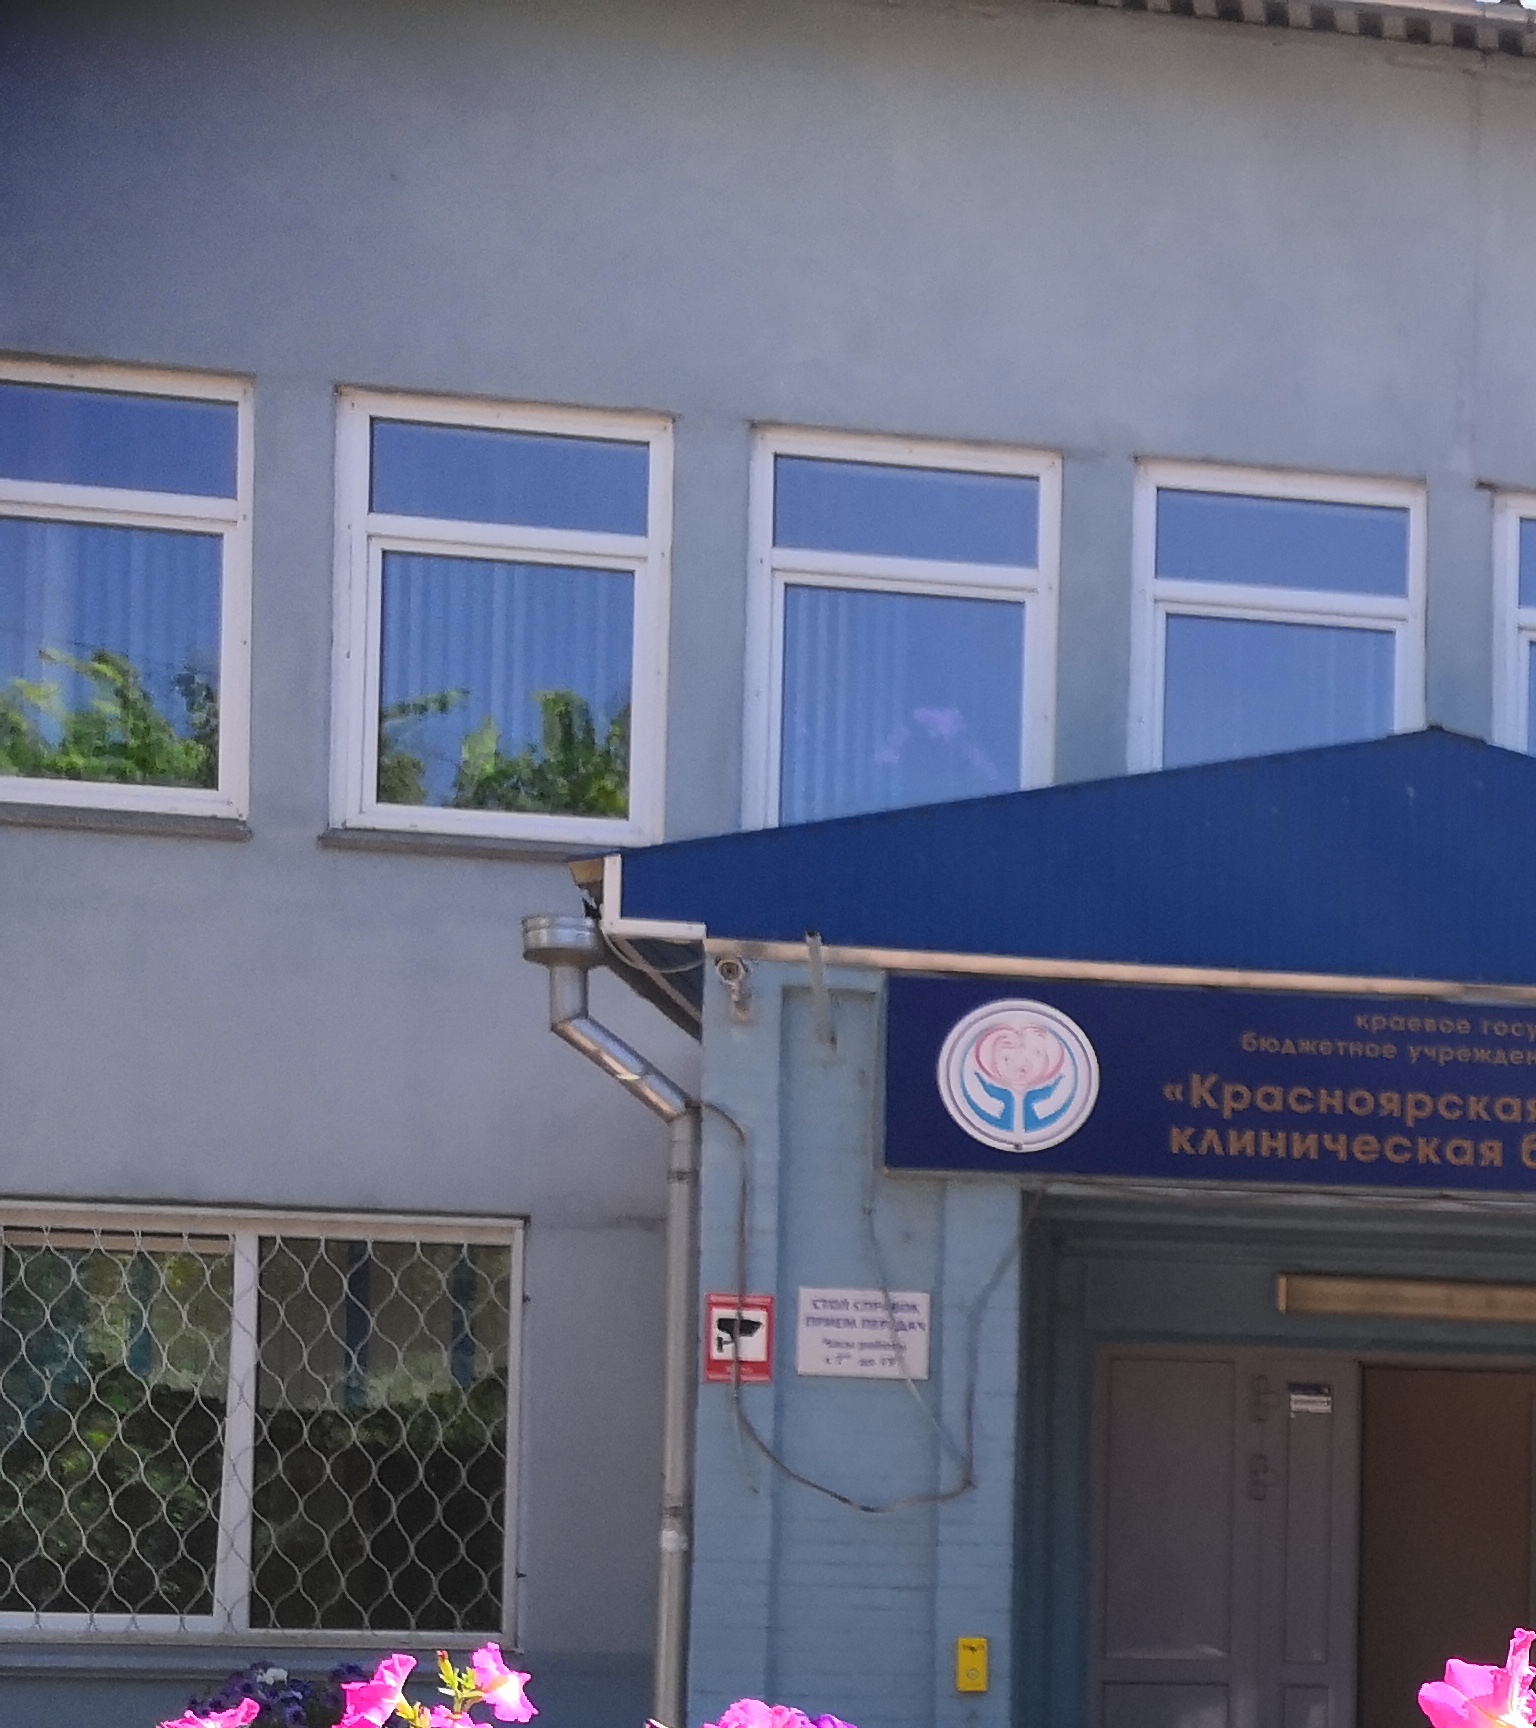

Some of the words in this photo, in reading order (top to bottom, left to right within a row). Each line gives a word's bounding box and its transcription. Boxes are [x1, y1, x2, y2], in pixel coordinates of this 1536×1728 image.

[1355, 1013, 1472, 1035] краевое
[1240, 1031, 1397, 1060] бюджетное
[1169, 1126, 1504, 1168] клиническая
